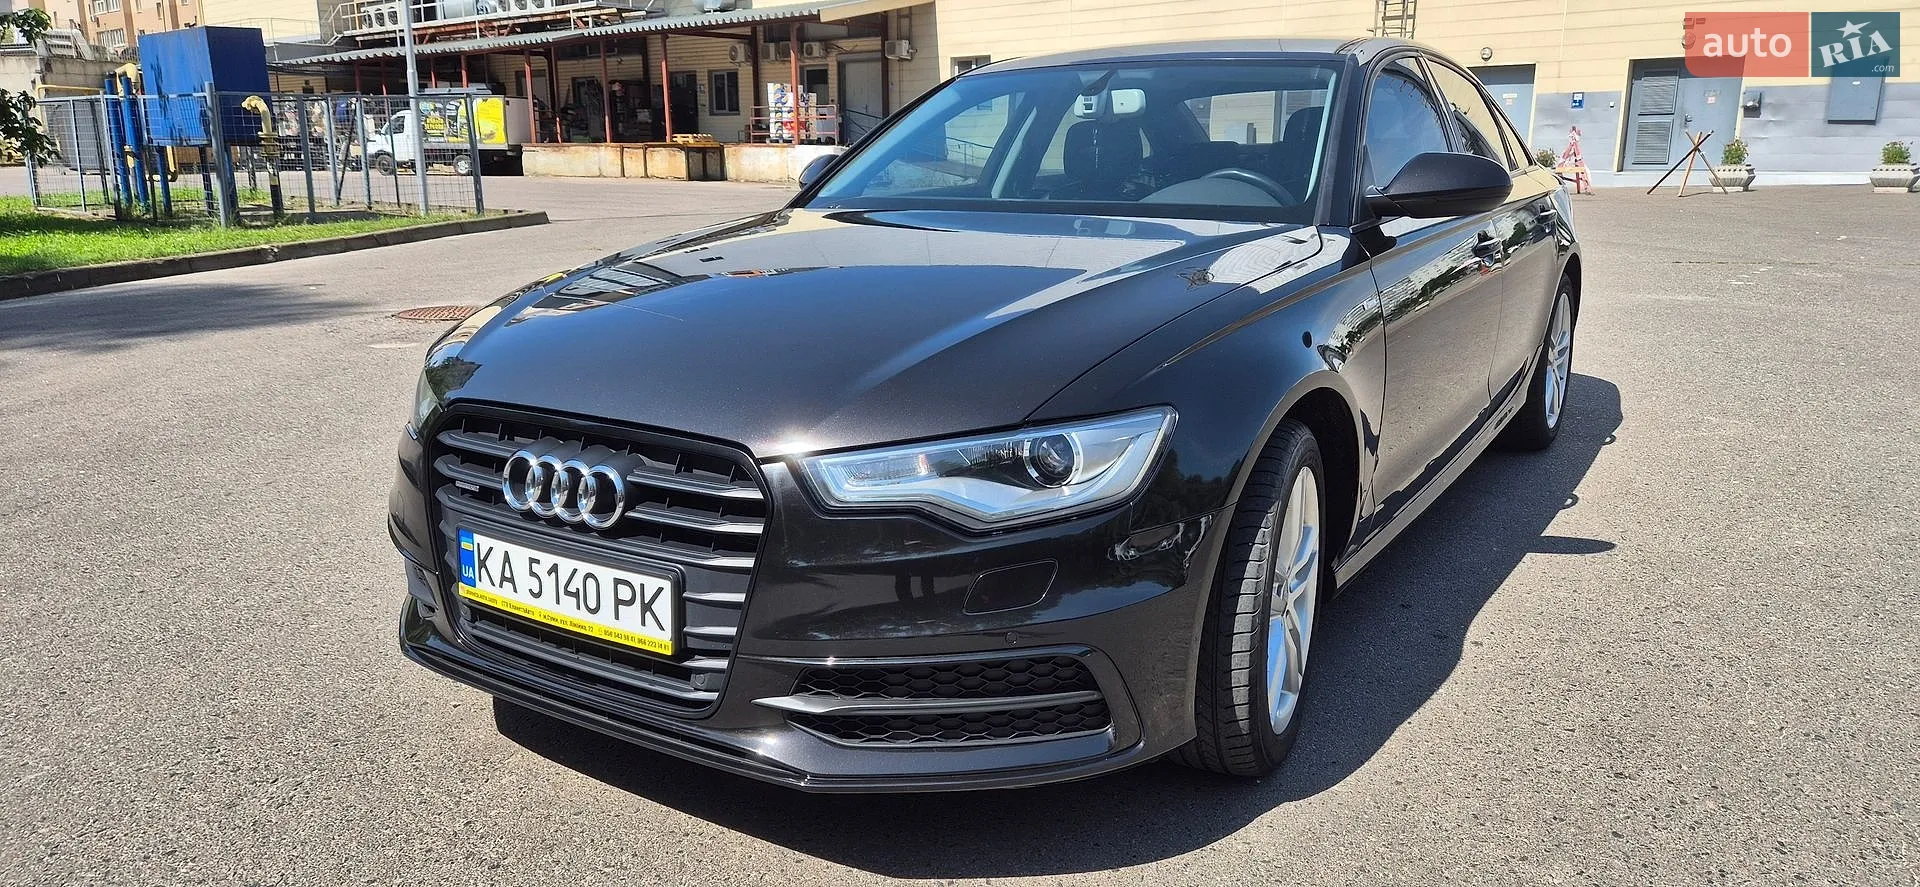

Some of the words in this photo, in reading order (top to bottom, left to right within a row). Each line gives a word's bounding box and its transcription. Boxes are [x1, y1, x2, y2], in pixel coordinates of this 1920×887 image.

[462, 564, 475, 580] UA
[476, 542, 518, 594] KA
[528, 556, 601, 615] 5140
[613, 577, 665, 632] PK
